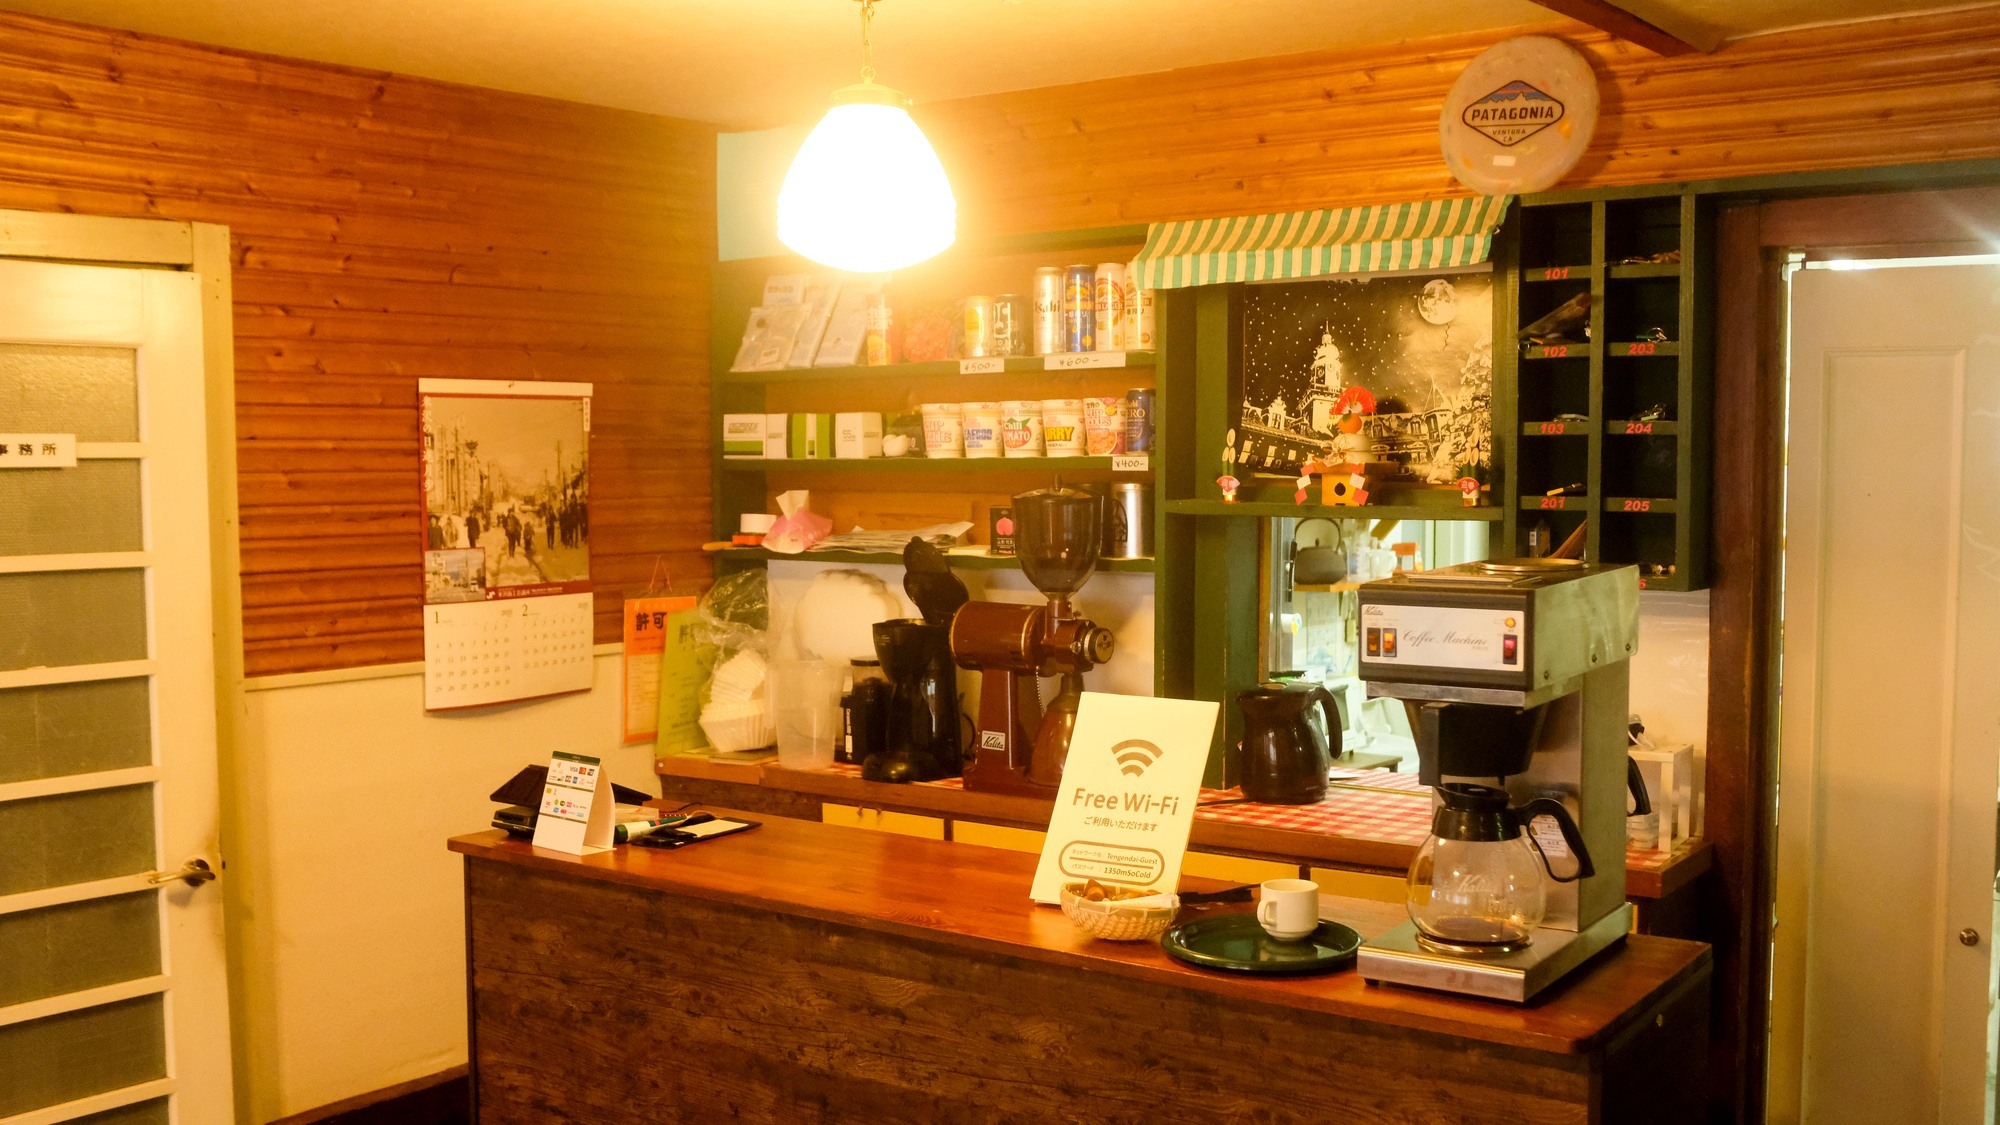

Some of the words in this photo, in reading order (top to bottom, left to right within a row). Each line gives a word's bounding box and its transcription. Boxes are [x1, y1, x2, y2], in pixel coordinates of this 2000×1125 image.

[1471, 106, 1554, 121] PATAGONIA
[1545, 268, 1568, 280] 101
[1543, 346, 1567, 358] 102
[1629, 342, 1655, 355] 203
[1540, 423, 1565, 434] 103
[1626, 422, 1653, 434] 204
[0, 443, 57, 456] 事務所
[1541, 497, 1565, 509] 201
[1624, 500, 1650, 512] 205
[522, 604, 528, 616] 2
[435, 612, 439, 623] 1
[636, 611, 667, 631] 許可
[1403, 628, 1434, 647] Coffee
[1442, 630, 1489, 646] Machine
[983, 736, 1004, 748] Kalita
[1072, 788, 1119, 810] Free
[1124, 793, 1179, 816] Wi-Fi
[1084, 816, 1159, 832] ご利用いただけます
[1107, 852, 1158, 865] Tengendai-Guest
[1104, 867, 1152, 879] 1350mSoCold
